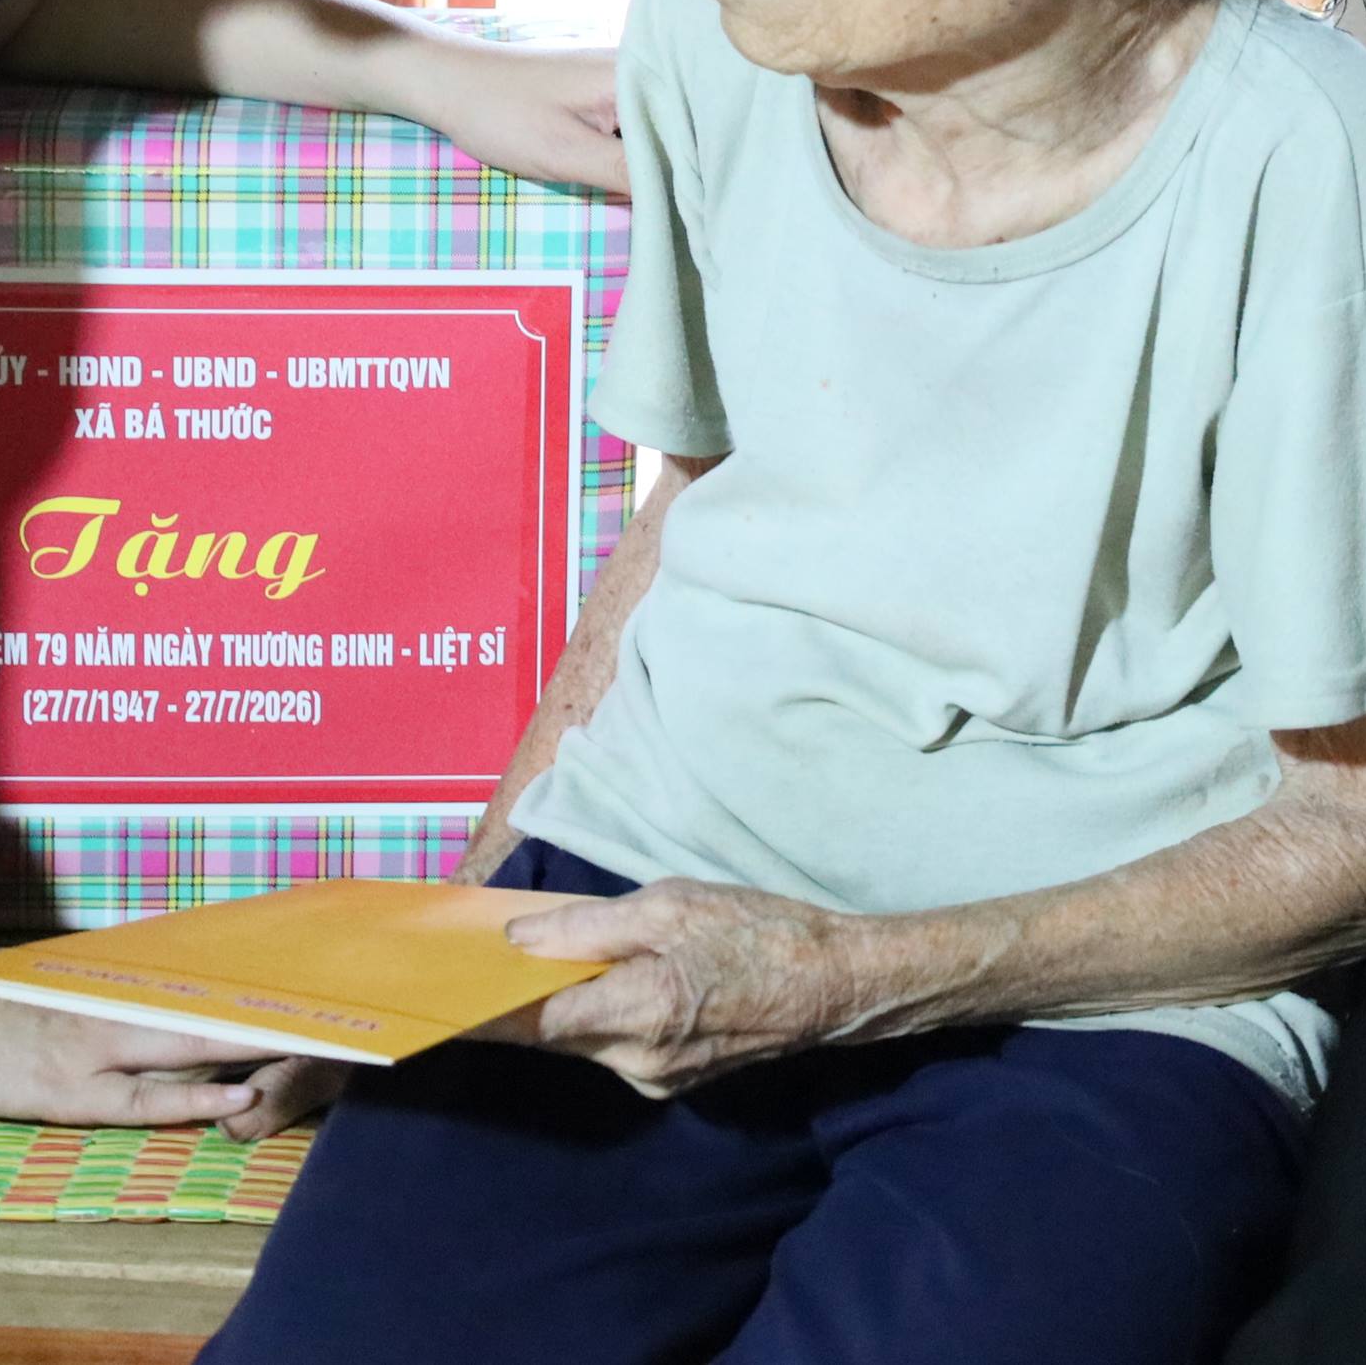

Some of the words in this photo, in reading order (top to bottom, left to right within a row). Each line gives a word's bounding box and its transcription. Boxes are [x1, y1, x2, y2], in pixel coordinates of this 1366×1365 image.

[59, 356, 142, 387] HĐND
[173, 356, 256, 388] UBND
[287, 357, 450, 392] UBMTTQVN
[74, 403, 115, 439] XÃ
[124, 402, 165, 439] BÁ
[174, 403, 272, 440] THƯỚC
[19, 496, 326, 600] Tặng
[35, 633, 67, 666] 79
[75, 626, 135, 666] NĂM
[143, 627, 213, 666] NGÀY
[220, 631, 323, 667] THƯƠNG
[331, 633, 394, 666] BINH
[419, 626, 471, 673] LIỆT
[479, 626, 506, 665] SĨ
[23, 689, 160, 725] (27/7/1947
[185, 690, 322, 725] 27/7/2026)
